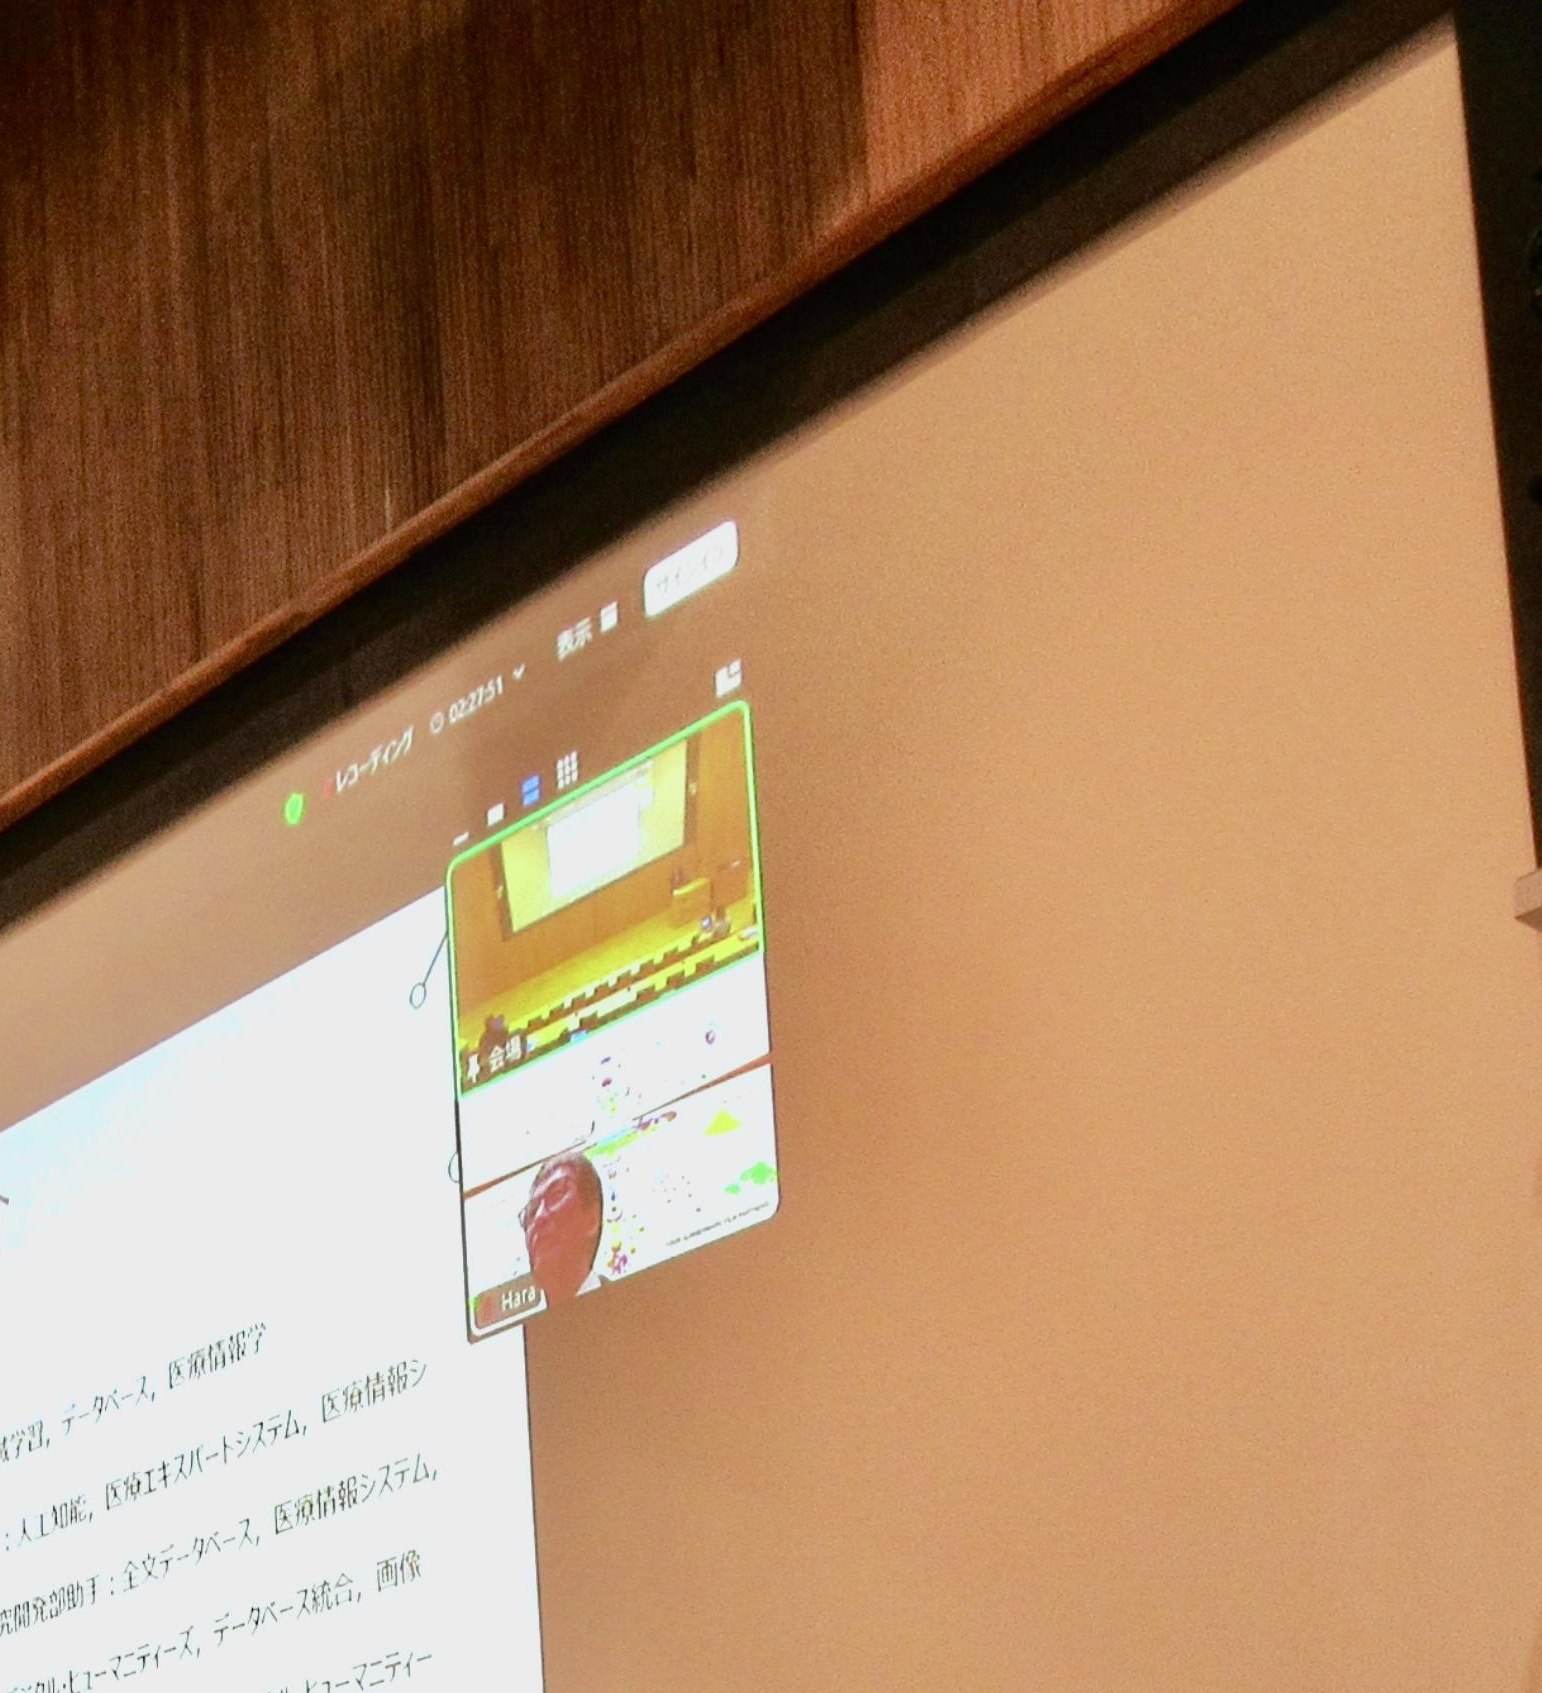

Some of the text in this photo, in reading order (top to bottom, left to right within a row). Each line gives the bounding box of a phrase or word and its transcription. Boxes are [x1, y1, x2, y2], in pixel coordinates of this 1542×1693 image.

[448, 674, 504, 724] 02:27:51
[335, 724, 414, 794] レコーディング
[488, 1036, 522, 1074] 会場
[500, 1285, 538, 1312] Hara
